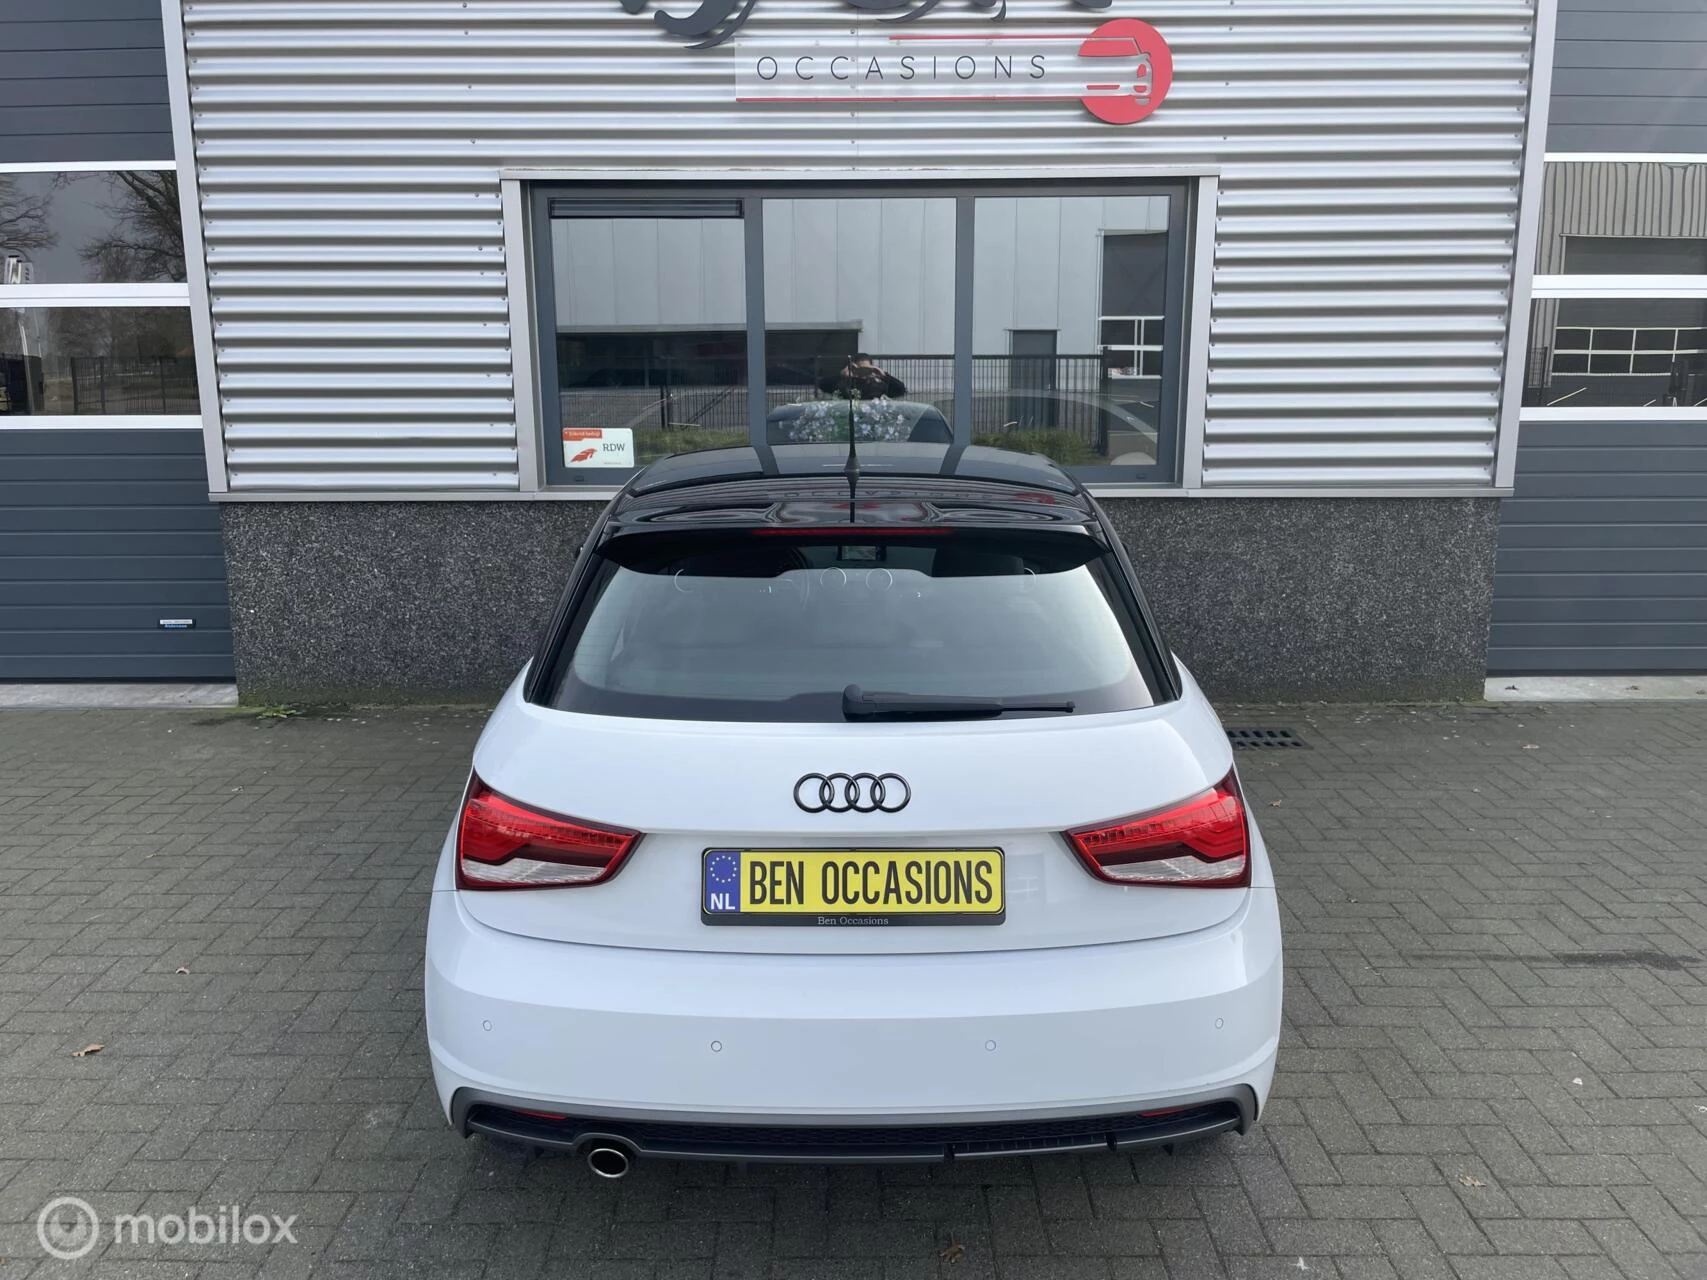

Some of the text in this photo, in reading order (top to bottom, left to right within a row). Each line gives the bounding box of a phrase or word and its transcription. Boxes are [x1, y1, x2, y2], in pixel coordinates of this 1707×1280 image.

[757, 55, 1045, 80] OCCASIONS
[602, 443, 625, 452] RDW
[750, 860, 992, 905] BEN OCCASIONS
[711, 893, 735, 910] NL
[818, 916, 889, 925] Ben Occasions
